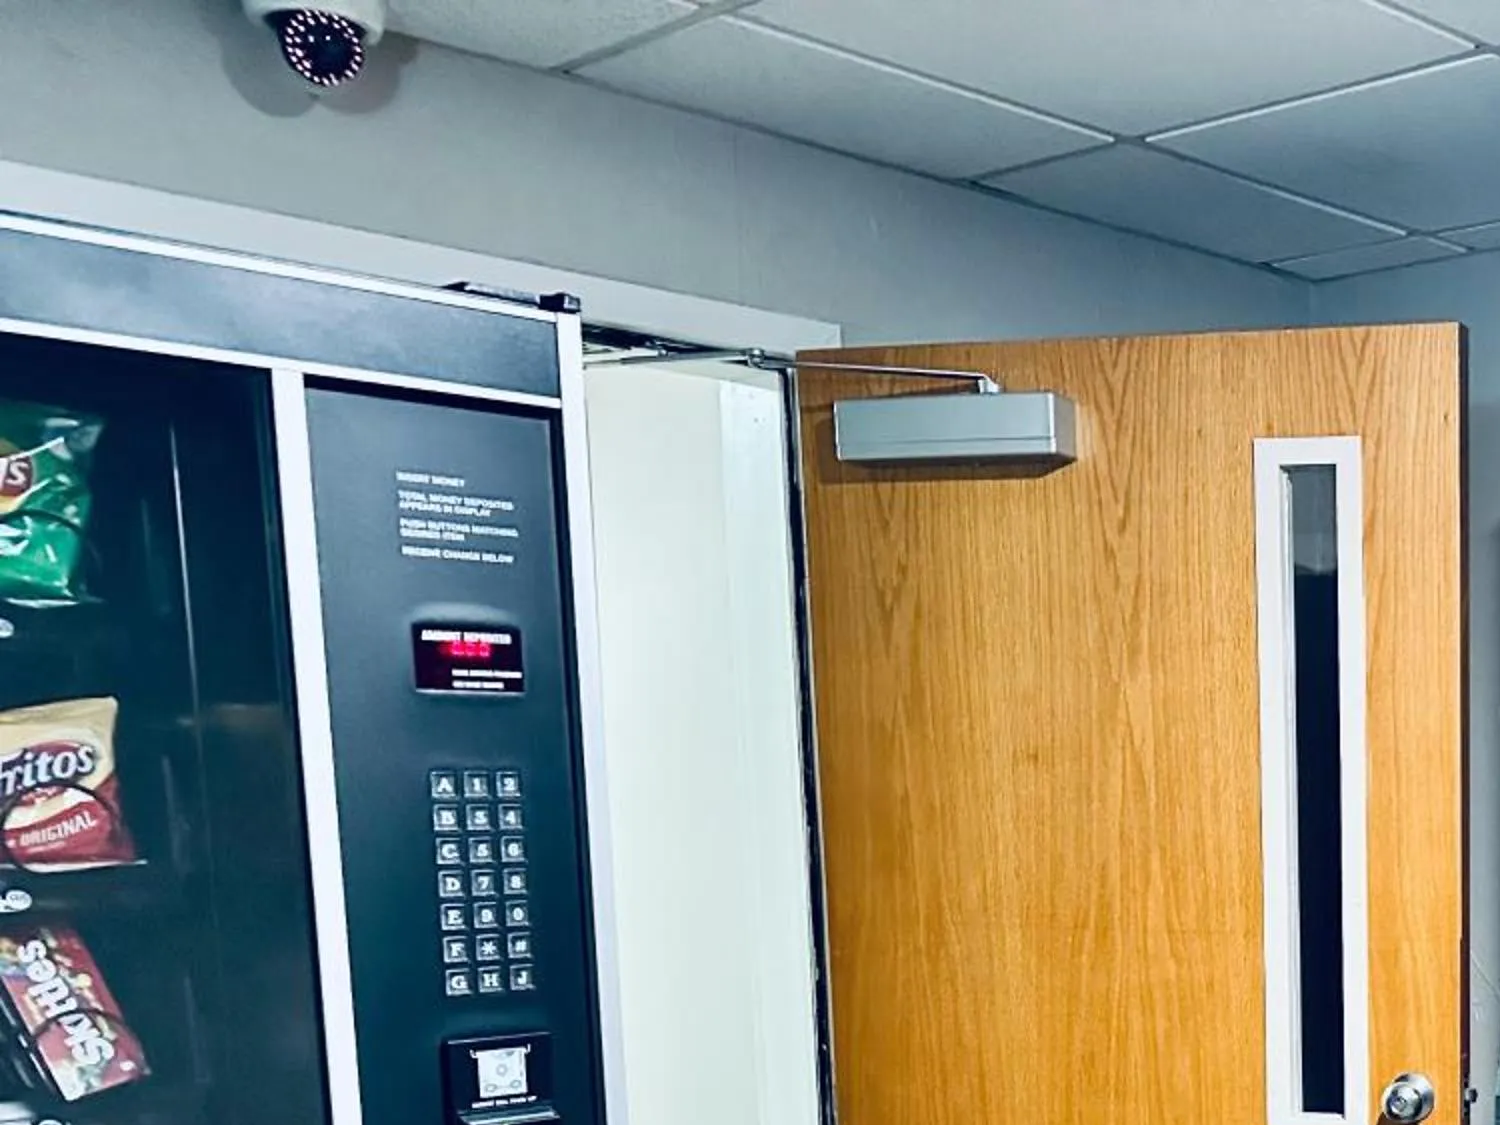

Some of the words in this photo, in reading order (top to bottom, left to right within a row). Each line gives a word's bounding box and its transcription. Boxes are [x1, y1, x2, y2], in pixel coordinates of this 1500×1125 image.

[431, 475, 465, 487] MONEY
[398, 489, 427, 501] TOTAL
[429, 493, 463, 505] MONEY
[482, 553, 514, 563] BELOW
[0, 745, 94, 796] ritos
[19, 810, 99, 847] ORIGINAL
